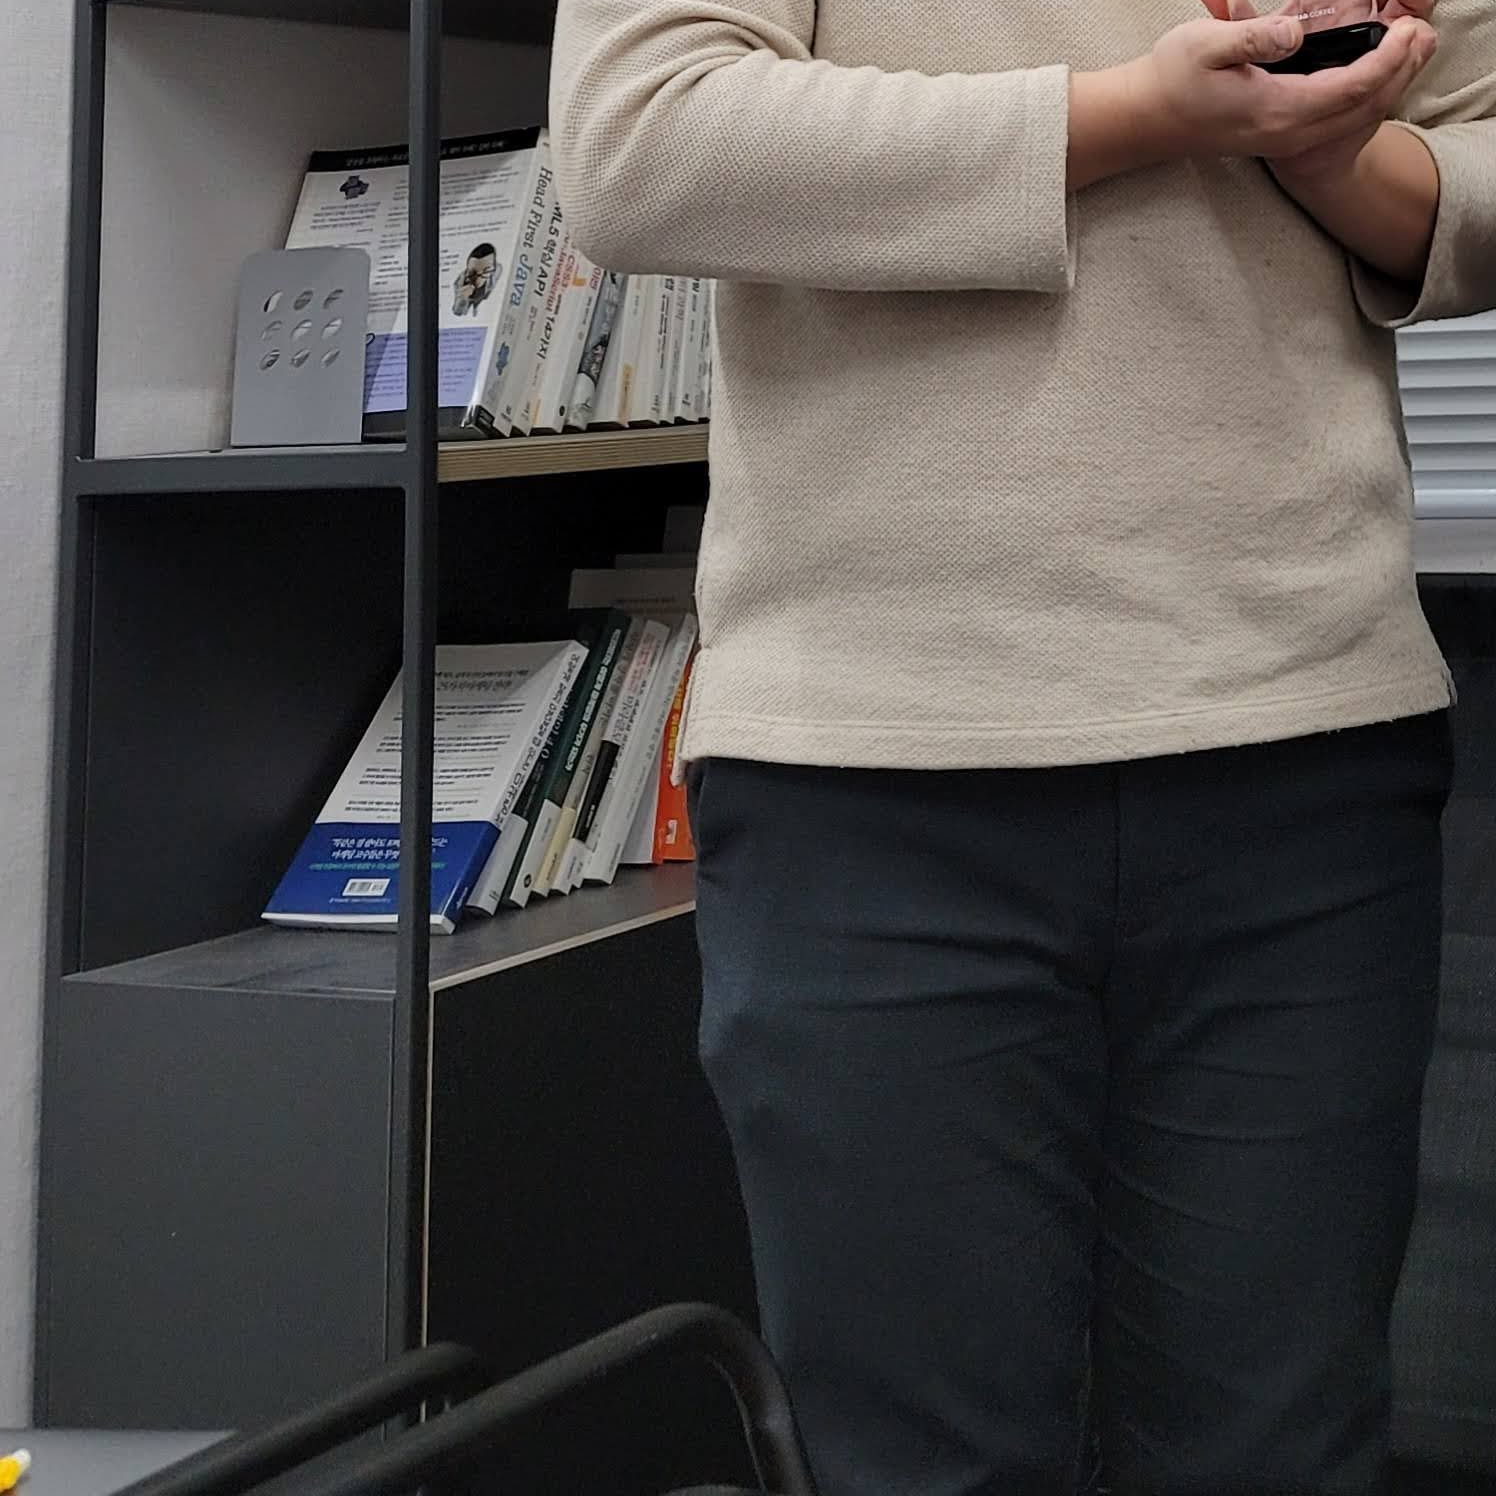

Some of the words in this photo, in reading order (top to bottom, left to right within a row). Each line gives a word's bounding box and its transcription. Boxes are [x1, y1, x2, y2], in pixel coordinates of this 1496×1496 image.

[530, 166, 554, 208] Head
[519, 208, 543, 249] First
[538, 238, 557, 267] 핵심
[559, 254, 576, 288] CSS3
[507, 253, 535, 307] Java
[531, 265, 549, 296] API
[544, 247, 567, 312] JavaScript
